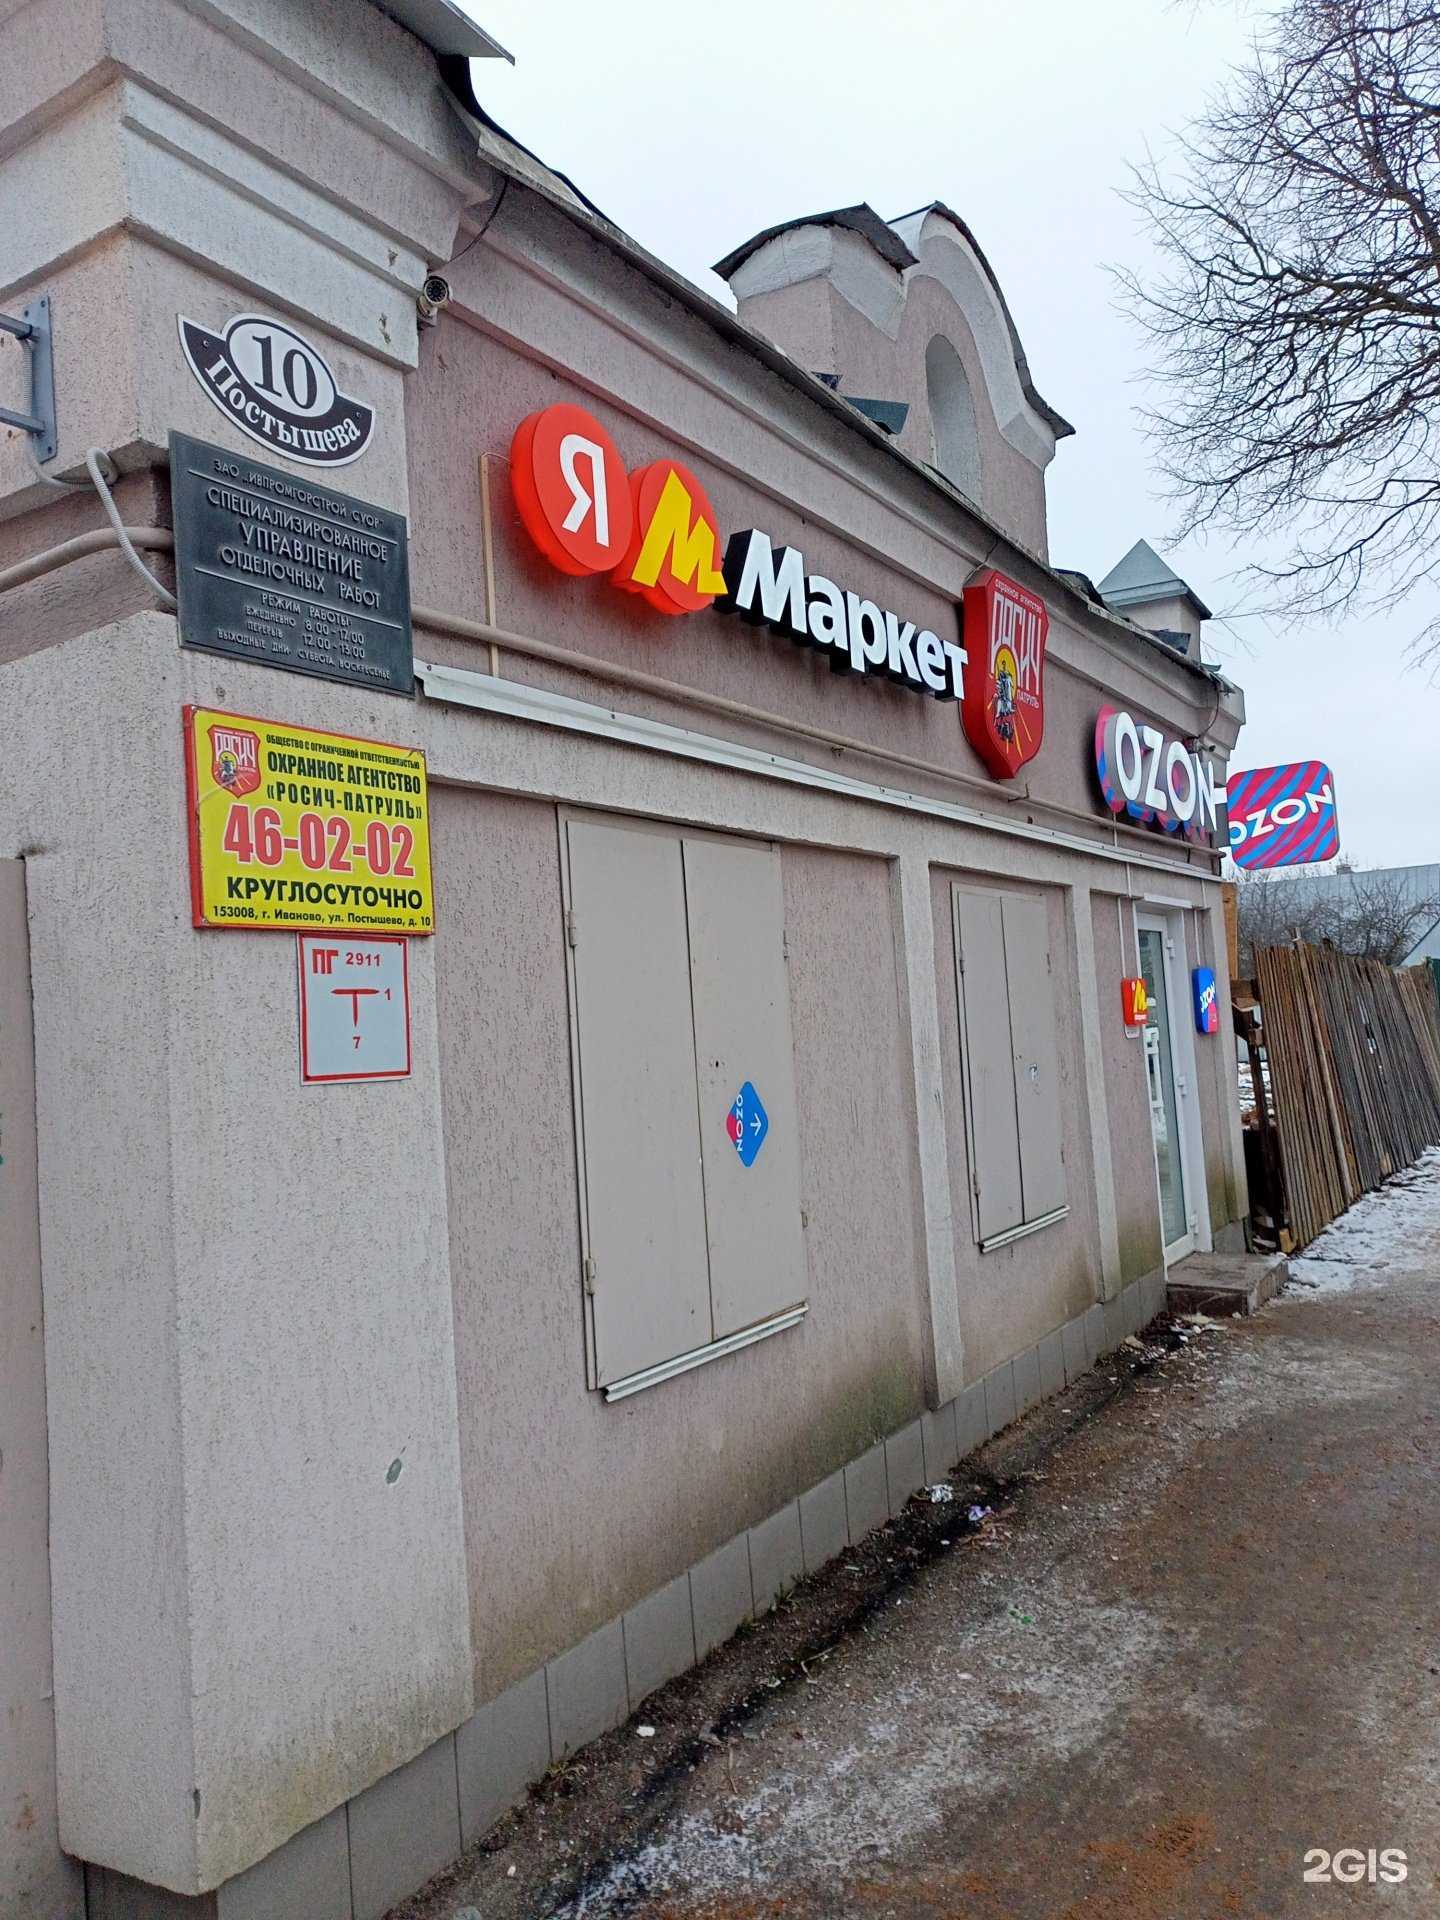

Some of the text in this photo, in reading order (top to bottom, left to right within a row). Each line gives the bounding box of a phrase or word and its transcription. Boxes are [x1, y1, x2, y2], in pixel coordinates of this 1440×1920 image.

[252, 335, 318, 409] 10
[204, 354, 361, 453] Постышева
[214, 459, 240, 477] ЗАО
[207, 487, 388, 561] СПЕЦИАЛИЗИРОВАННОЕ
[240, 522, 363, 580] УПРАВЛЕНИЕ
[560, 434, 609, 547] Я
[735, 528, 968, 700] Маркет
[222, 546, 380, 608] ОТДЕЛОЧНЫХ РАБОТ
[246, 605, 297, 627] ЕЖЕДНЕВНО
[261, 593, 301, 615] РЕЖИМ
[266, 734, 304, 750] ОБЩЕСТВО
[311, 742, 359, 759] ОГРАНИЧЕННОЙ
[267, 751, 421, 795] ОХРАННОЕ АГЕНТСТВО
[1115, 711, 1218, 832] OZON
[266, 781, 422, 820] «РОСИЧ-ПАТРУЛЬ»
[223, 803, 415, 878] 46-02-02
[227, 876, 424, 910] КРУГЛОСУТОЧНО
[213, 906, 259, 921] 153008,
[262, 911, 270, 919] г.
[274, 908, 325, 924] Иваново,
[328, 913, 344, 924] ул.
[408, 918, 417, 928] д.
[421, 916, 431, 927] 10
[312, 948, 382, 975] ПГ 2911
[384, 988, 392, 1001] 1
[353, 1036, 361, 1049] 7
[736, 1094, 744, 1152] OZON
